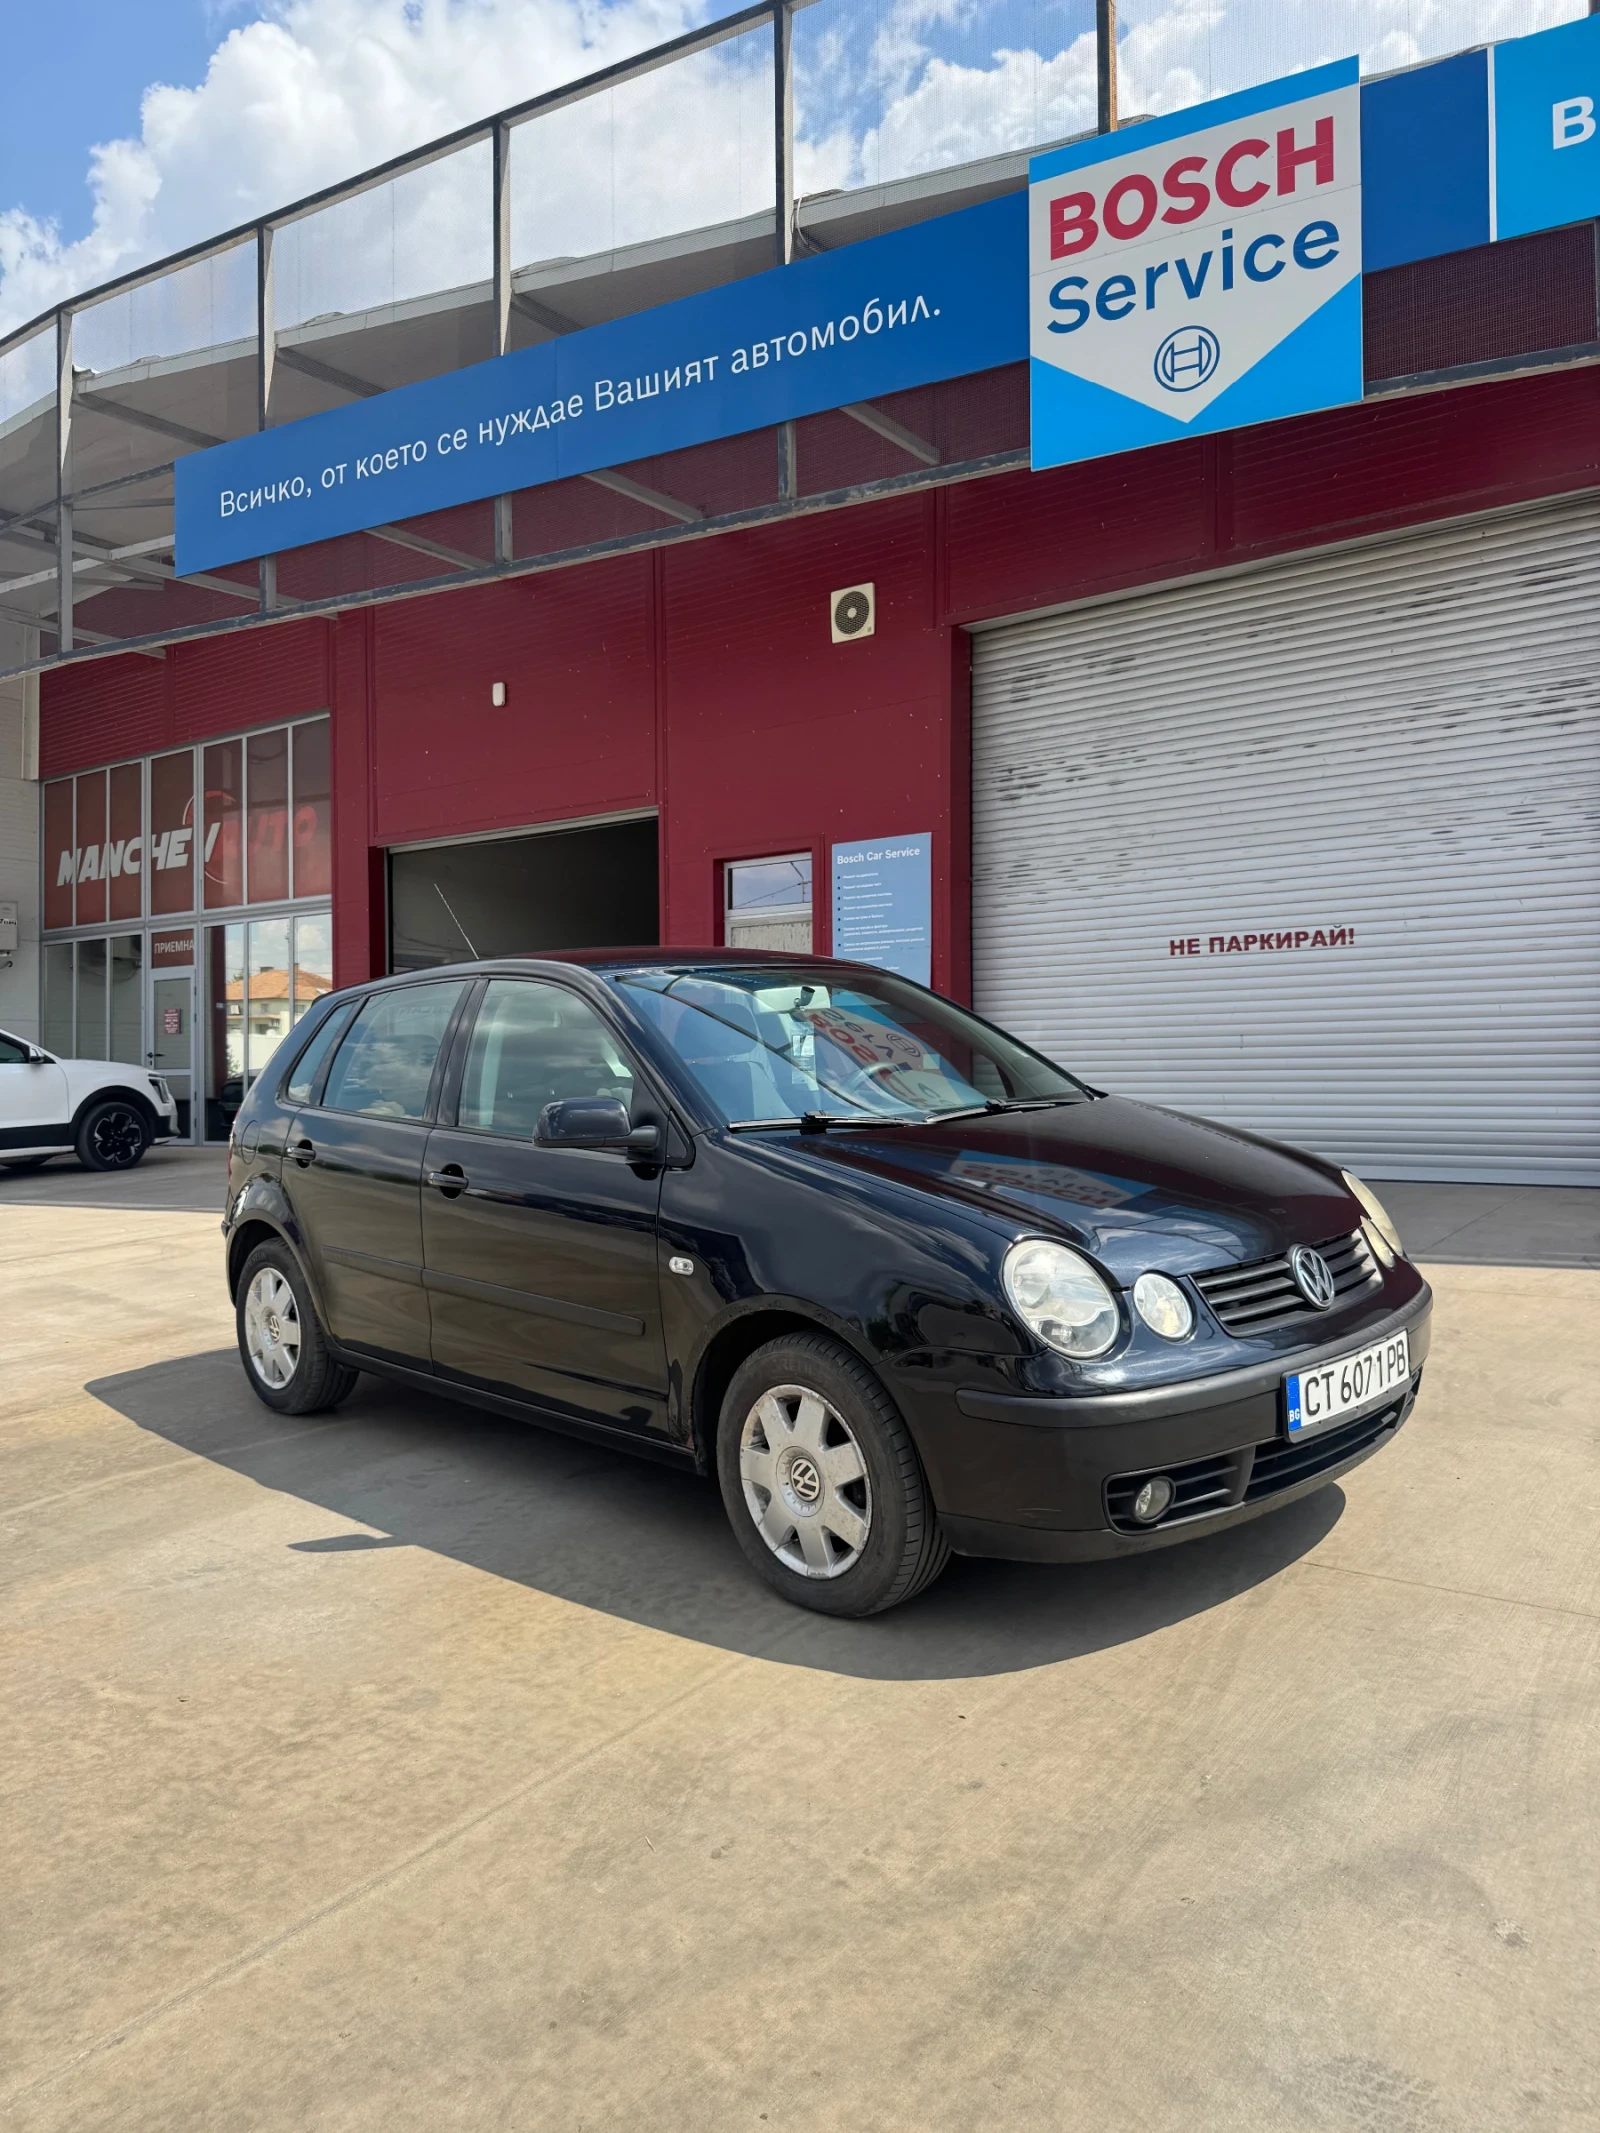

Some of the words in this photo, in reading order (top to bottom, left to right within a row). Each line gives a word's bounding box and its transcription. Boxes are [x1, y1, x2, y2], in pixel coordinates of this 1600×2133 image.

[1050, 116, 1334, 260] BOSCH
[1047, 220, 1339, 334] Service
[220, 476, 312, 518] Всичко,
[321, 463, 347, 489] от
[356, 440, 428, 480] което
[437, 428, 468, 455] се
[478, 394, 584, 446] нуждае
[594, 355, 719, 412] Вашият
[730, 295, 941, 374] автомобил.
[57, 822, 221, 887] MANCHEV
[837, 853, 864, 865] Bosch
[866, 851, 883, 861] Car
[885, 846, 920, 859] Service
[1169, 938, 1200, 956] НЕ
[1208, 924, 1355, 953] ПАРКИРАЙ!
[1288, 1408, 1300, 1422] BG
[1304, 1370, 1335, 1417] CT
